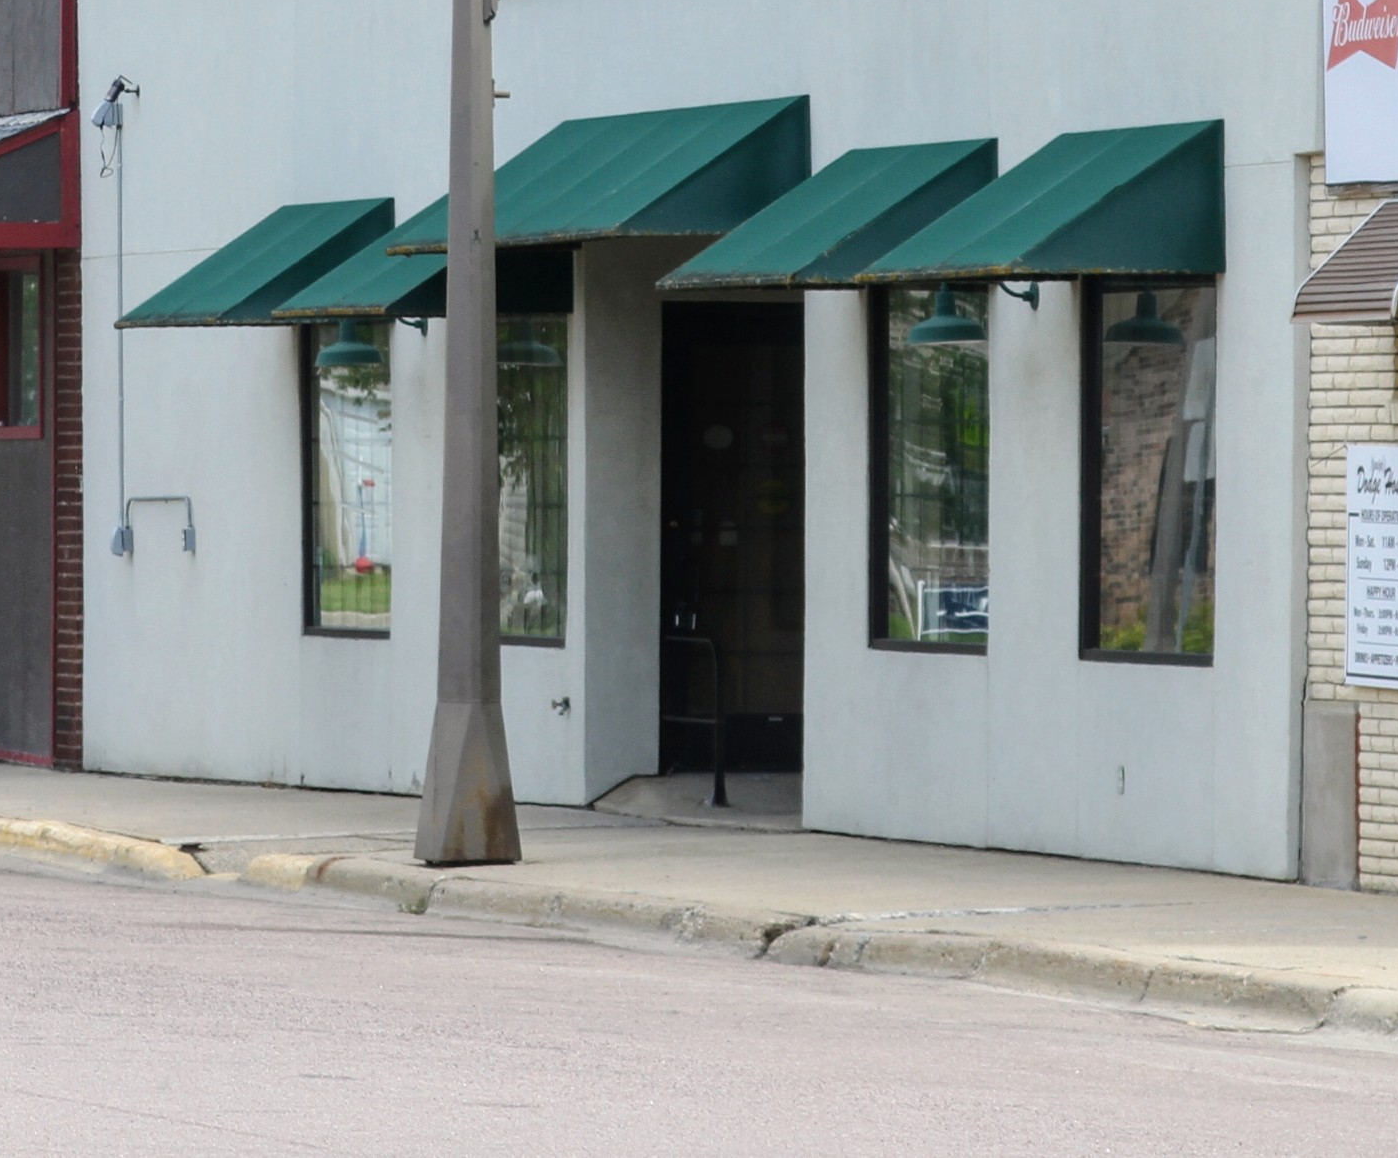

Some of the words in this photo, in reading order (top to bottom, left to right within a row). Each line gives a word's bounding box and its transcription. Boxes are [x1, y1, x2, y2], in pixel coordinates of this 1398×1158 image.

[1357, 465, 1382, 504] Dodge
[1366, 585, 1381, 598] HAPPY
[1382, 586, 1397, 599] HOUR
